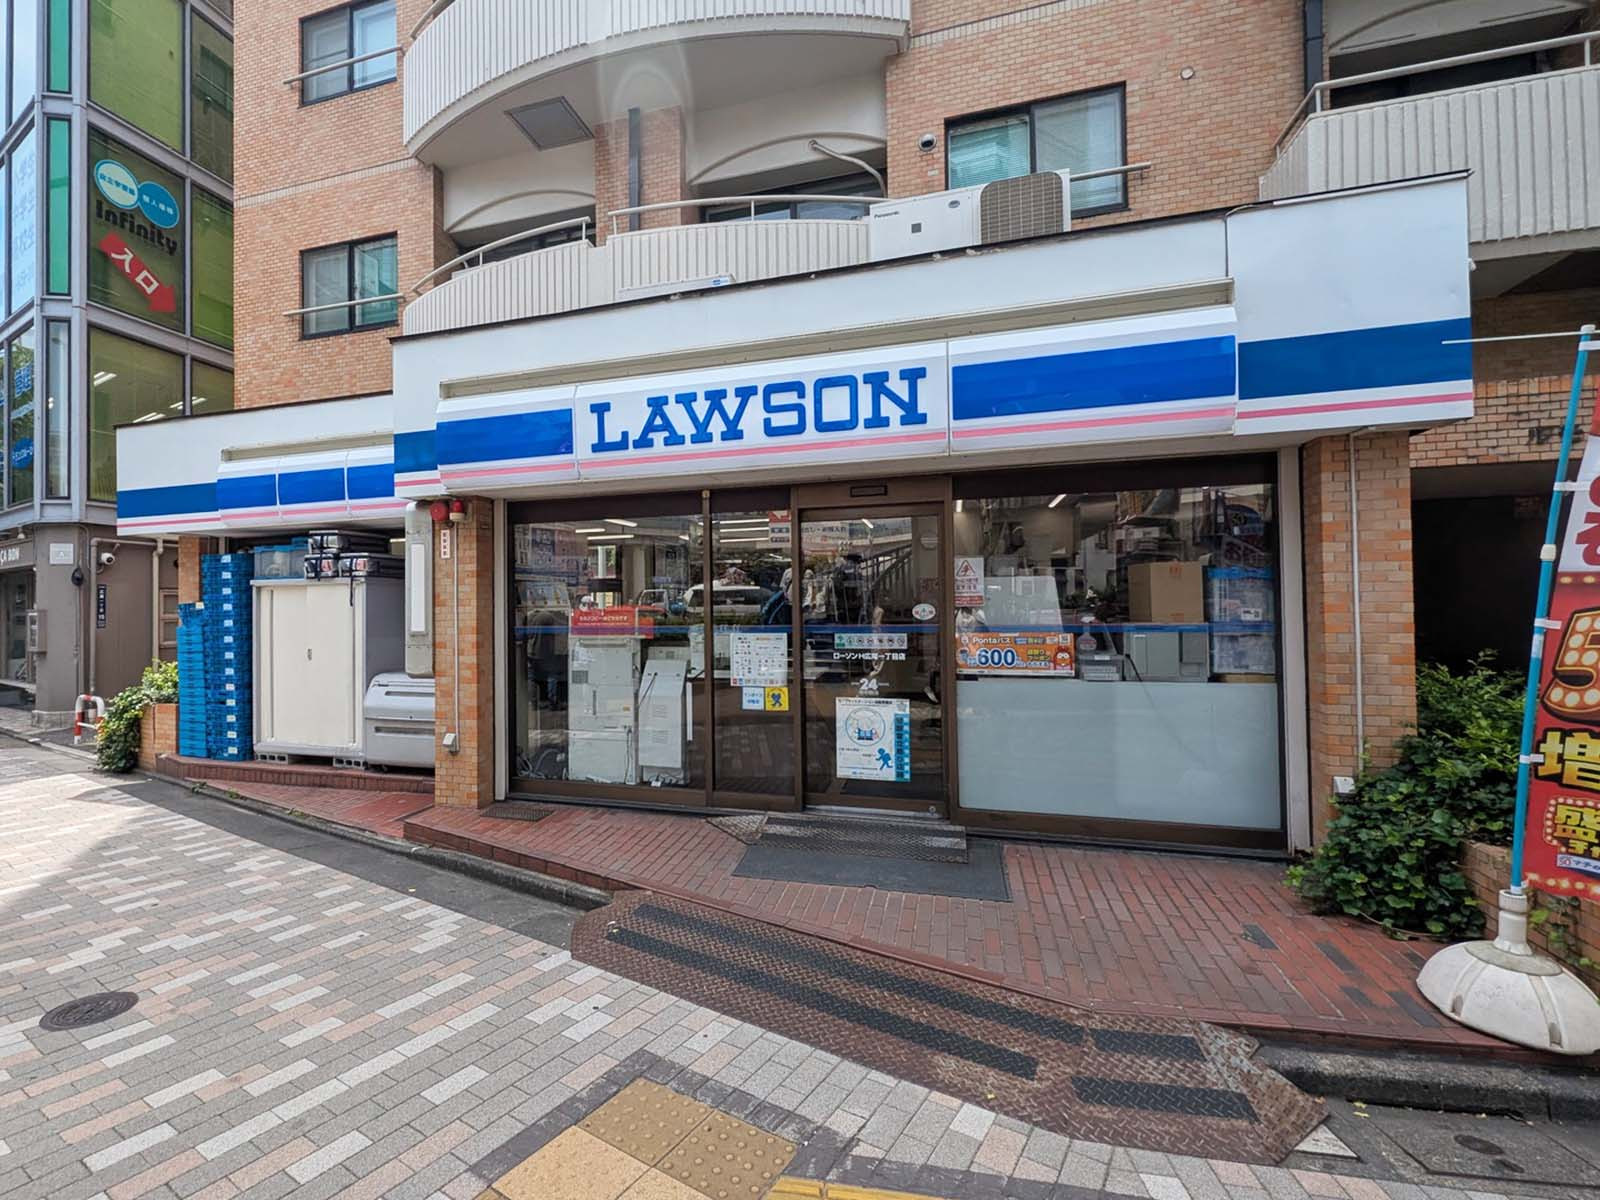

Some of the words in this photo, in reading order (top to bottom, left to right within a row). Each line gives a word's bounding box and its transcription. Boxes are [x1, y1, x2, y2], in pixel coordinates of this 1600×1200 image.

[96, 200, 178, 256] Infinity
[111, 247, 159, 295] 入口
[590, 366, 927, 453] LAWSON
[976, 647, 1017, 667] 600
[860, 678, 878, 690] 24
